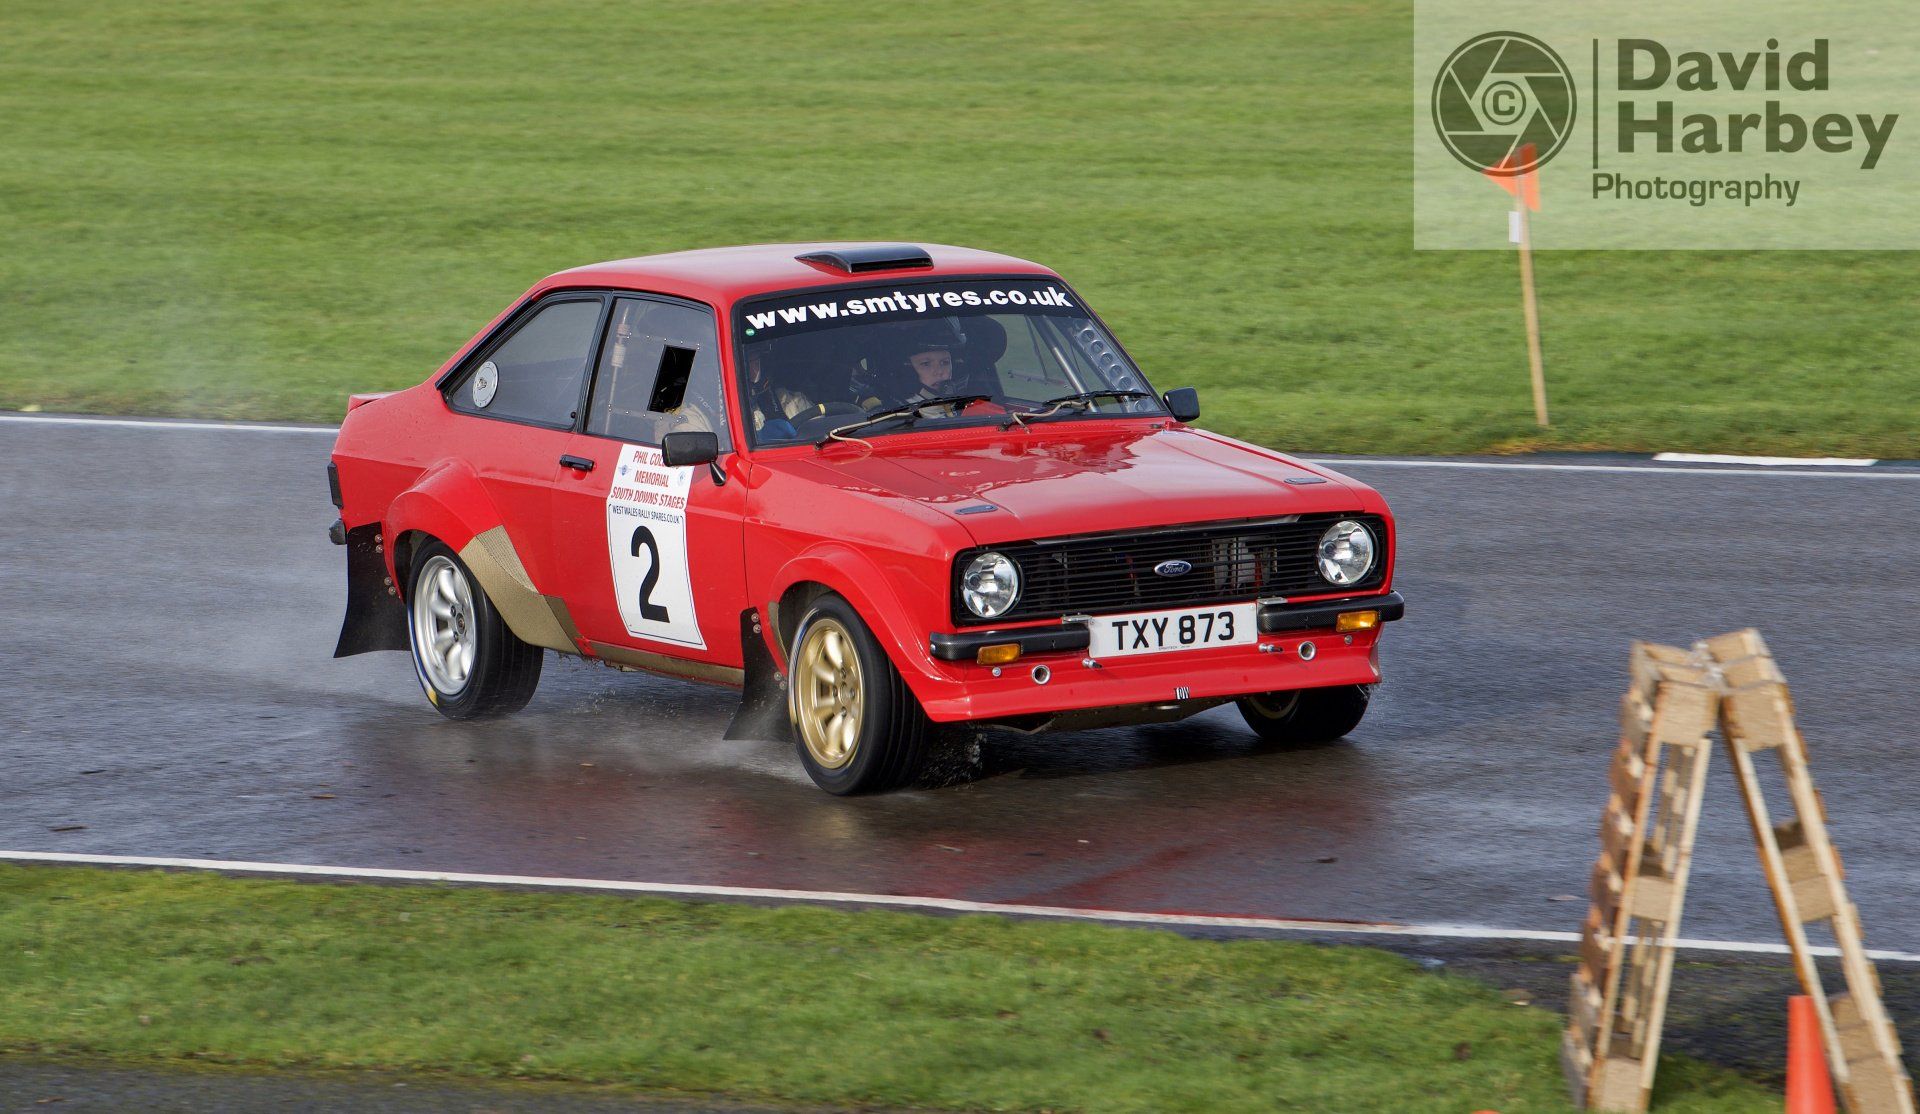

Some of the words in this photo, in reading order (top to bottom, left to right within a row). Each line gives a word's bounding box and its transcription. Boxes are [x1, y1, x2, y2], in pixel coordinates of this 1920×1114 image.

[746, 286, 1074, 330] www.smtyres.co.uk
[633, 450, 648, 464] PHIL
[634, 470, 669, 487] MEMORIAL
[611, 486, 634, 500] SOUTH
[633, 490, 658, 505] DOWNS
[659, 494, 685, 509] STAGES
[612, 505, 624, 515] WEST
[624, 507, 638, 517] WALES
[638, 509, 650, 519] RALLY
[631, 525, 670, 623] 2
[1164, 562, 1185, 574] Ford
[1112, 617, 1168, 650] TXY
[1178, 611, 1234, 645] 873
